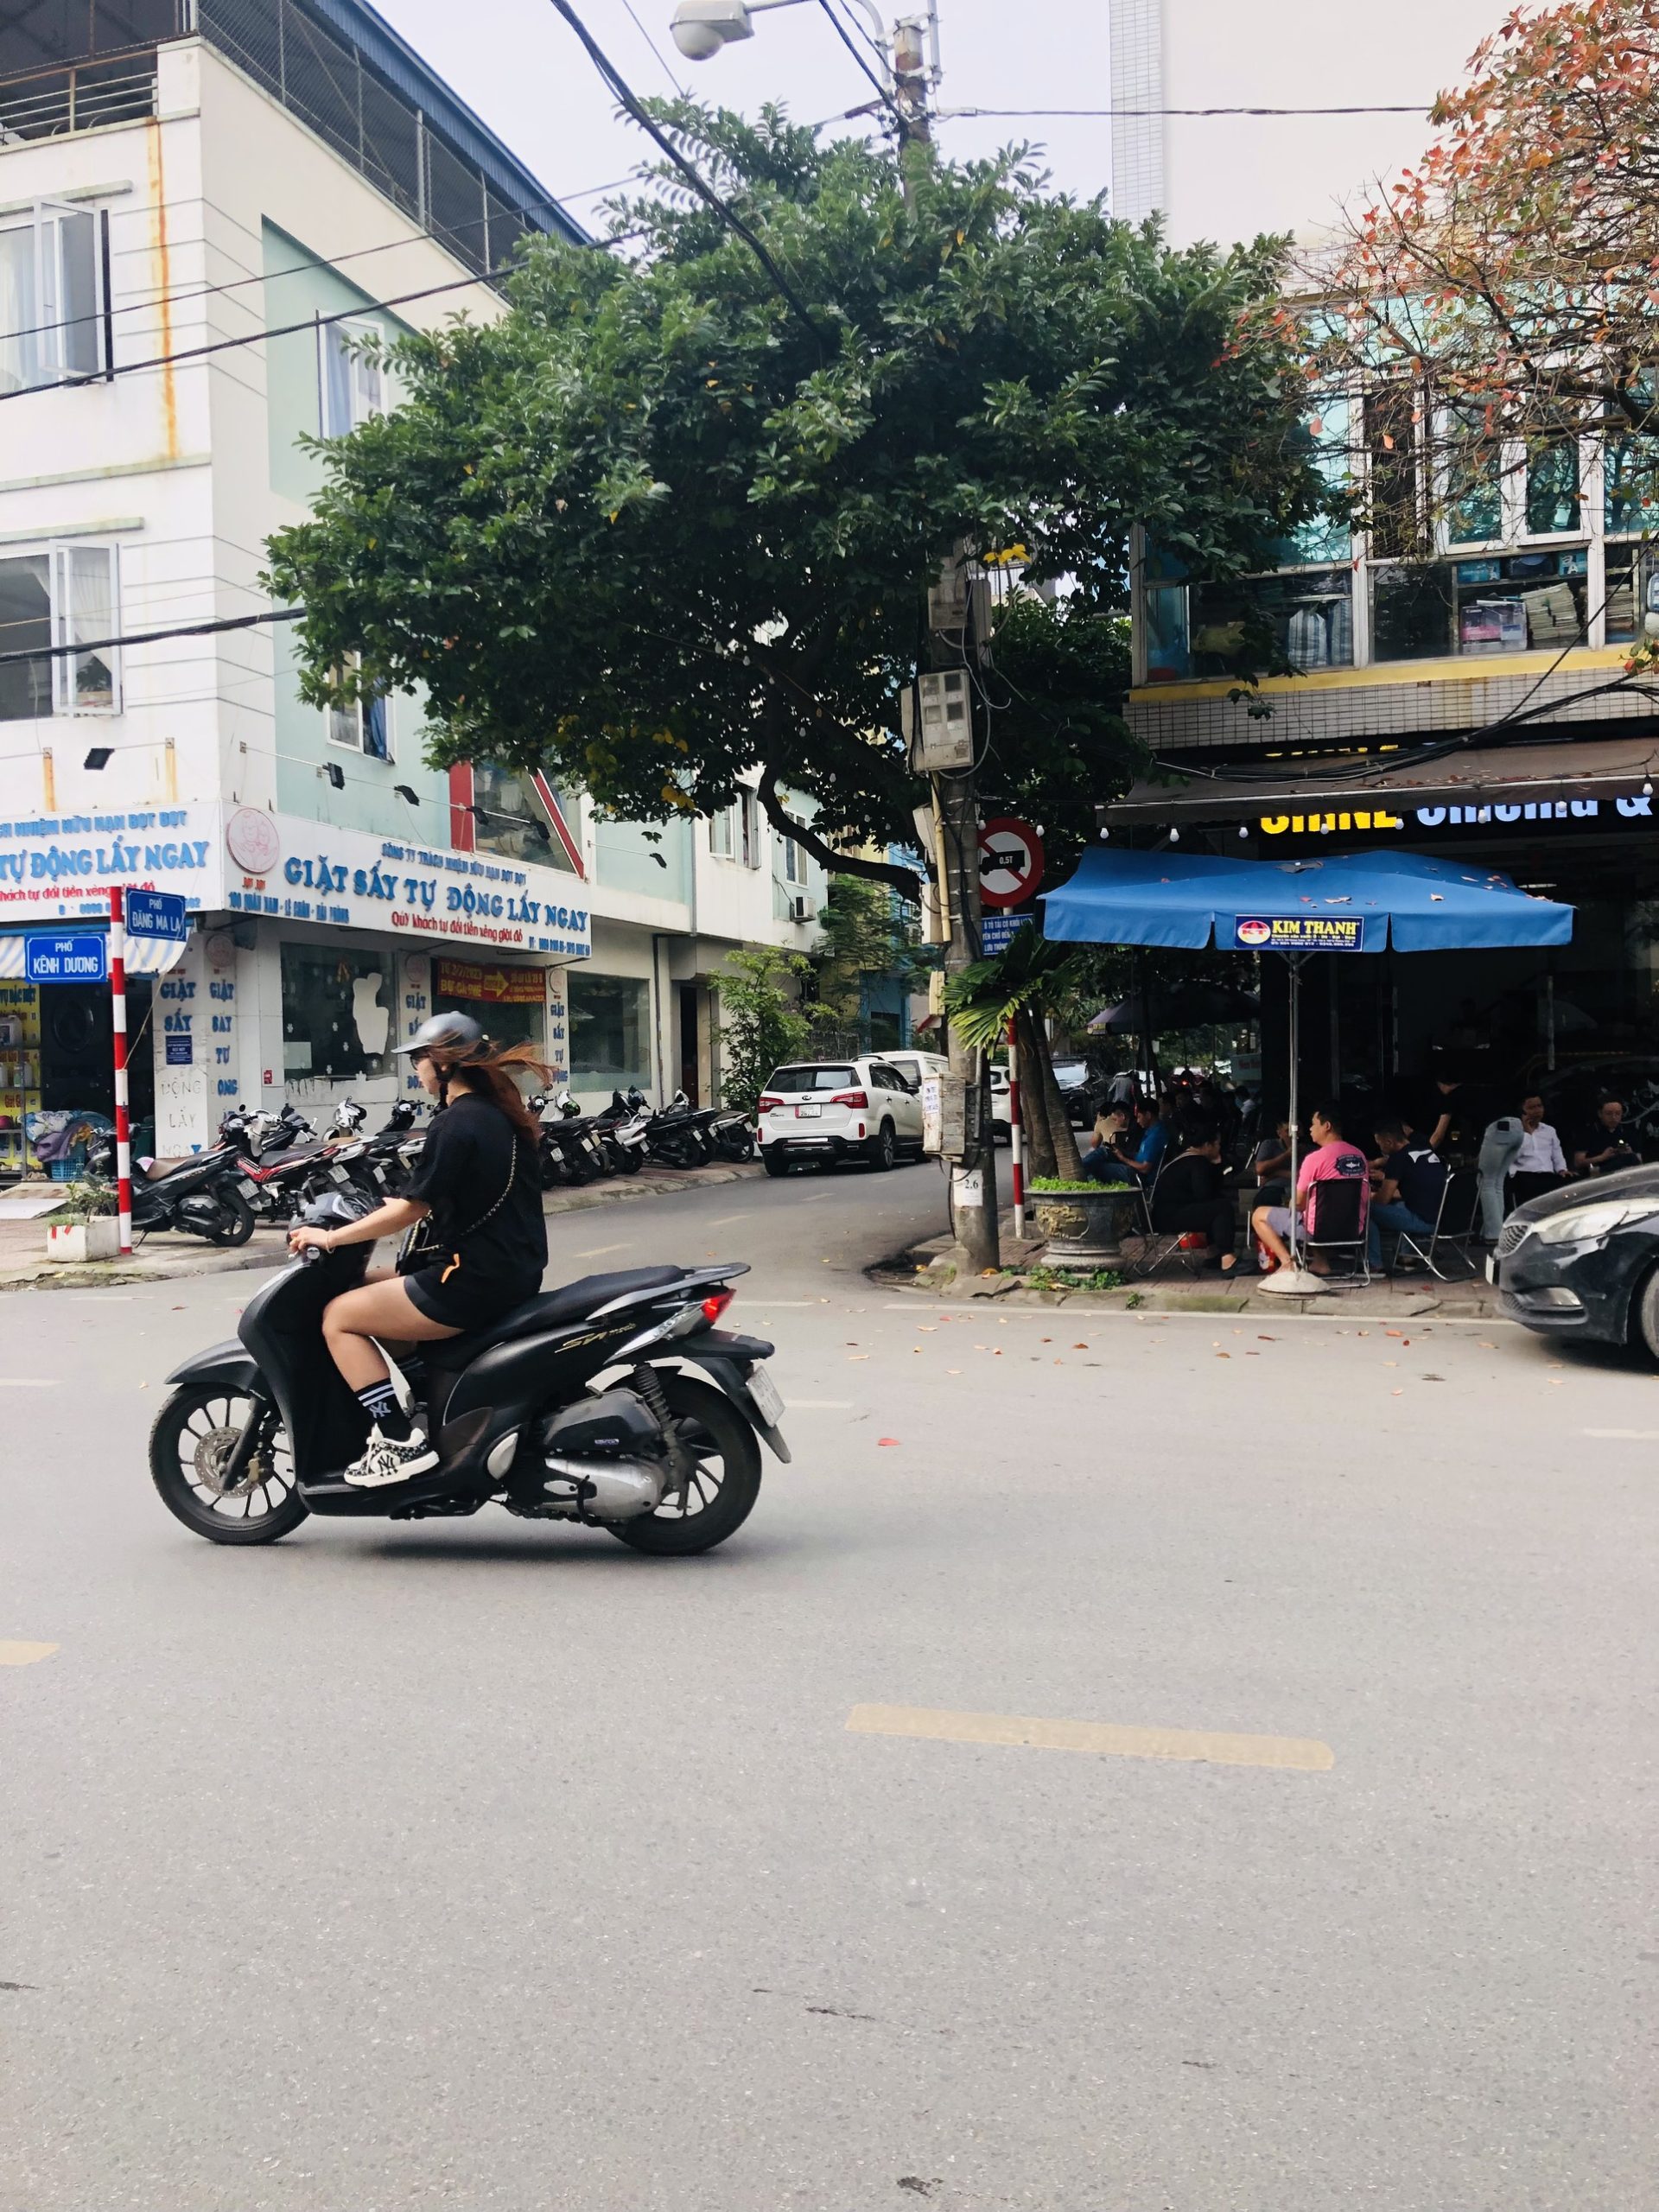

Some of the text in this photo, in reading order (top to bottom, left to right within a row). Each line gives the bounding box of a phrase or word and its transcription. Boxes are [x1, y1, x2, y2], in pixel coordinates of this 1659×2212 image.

[30, 845, 92, 881] ĐỘNG
[96, 835, 141, 874] LẤY
[144, 841, 210, 870] NGAY
[284, 855, 588, 932] GIẶT SẤY TỰ ĐỘNG LẤY NGAY
[149, 898, 162, 910] PHỐ
[132, 909, 153, 931] ĐẶNG
[156, 915, 168, 931] MA
[170, 917, 181, 932] LA
[391, 911, 410, 927] Quý
[412, 913, 437, 931] khách
[1272, 920, 1357, 935] KIM THANH
[55, 938, 74, 952] PHỐ
[33, 955, 99, 974] KÊNH DƯƠNG
[160, 977, 196, 1001] GIẶT
[209, 979, 234, 1001] GIẶT
[406, 992, 426, 1011] GIẶT
[550, 1001, 564, 1018] GIẶT
[164, 1007, 193, 1032] SẤY
[964, 1179, 979, 1190] 2.6
